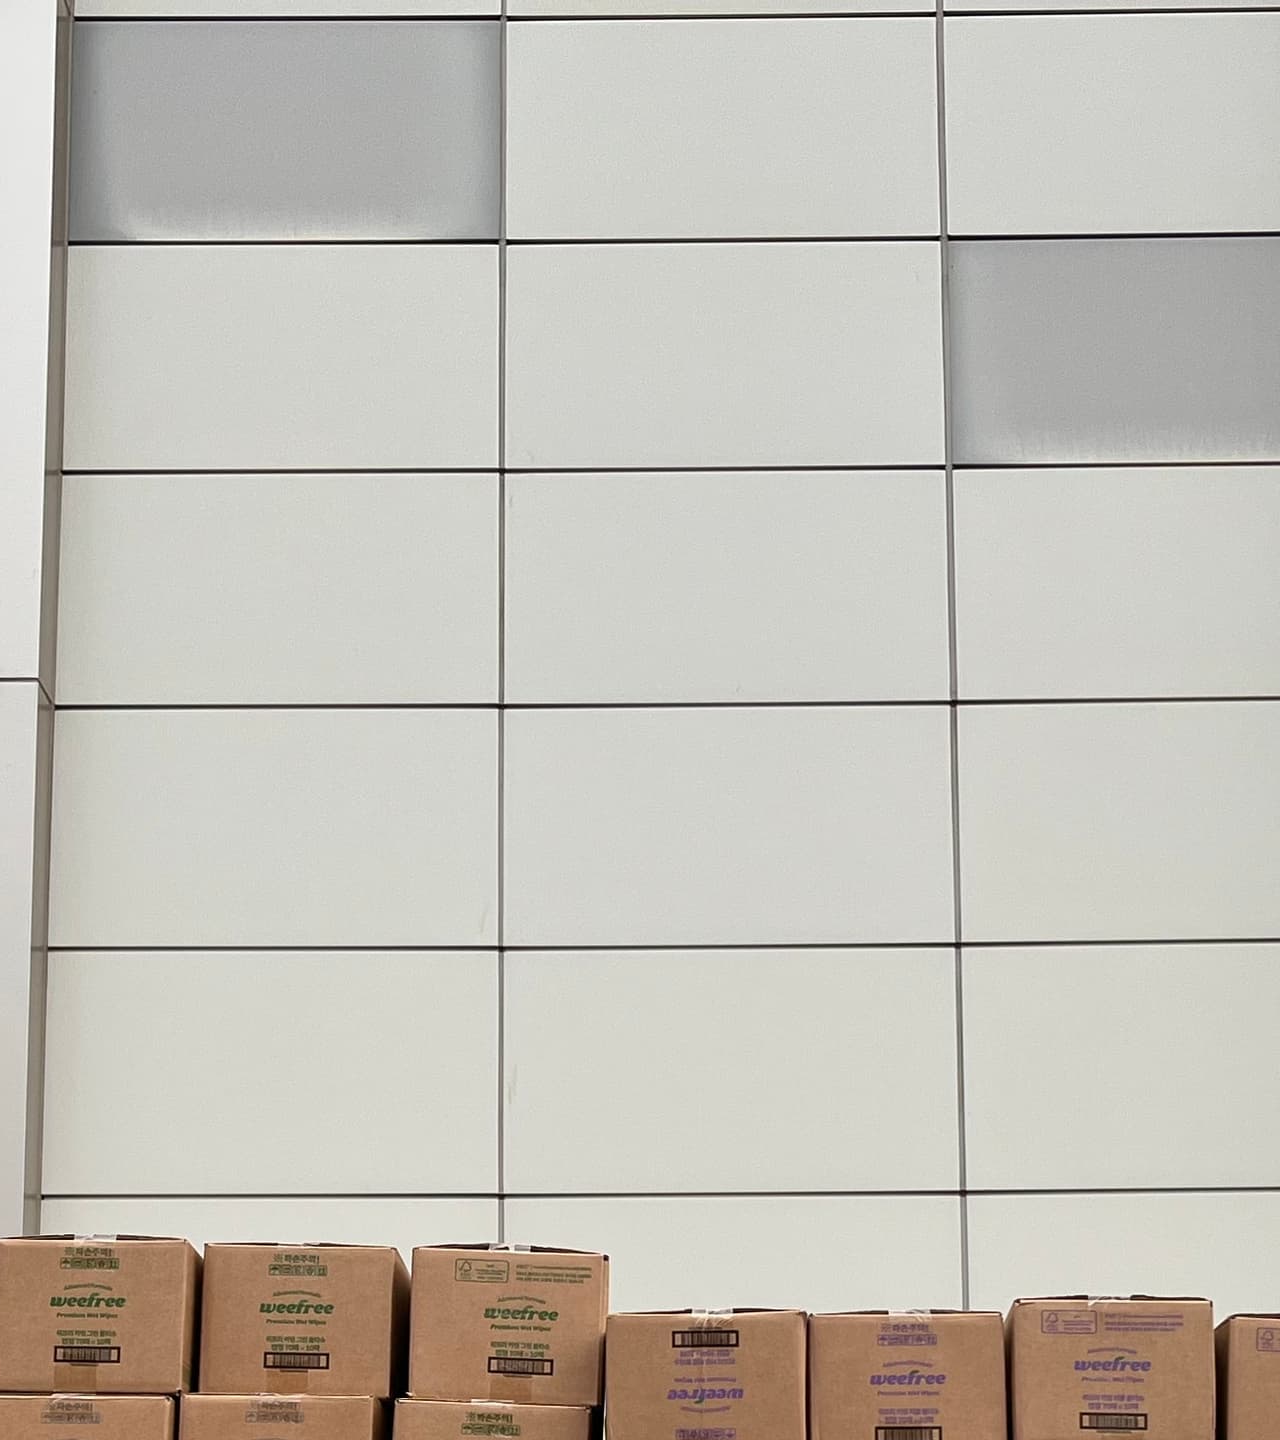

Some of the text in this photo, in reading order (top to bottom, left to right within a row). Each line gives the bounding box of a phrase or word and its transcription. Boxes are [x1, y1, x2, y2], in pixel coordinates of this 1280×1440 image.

[50, 1293, 126, 1308] weefree
[260, 1300, 334, 1315] weefree
[484, 1305, 559, 1320] weefree
[1074, 1356, 1151, 1373] weefree
[870, 1370, 946, 1387] weefree
